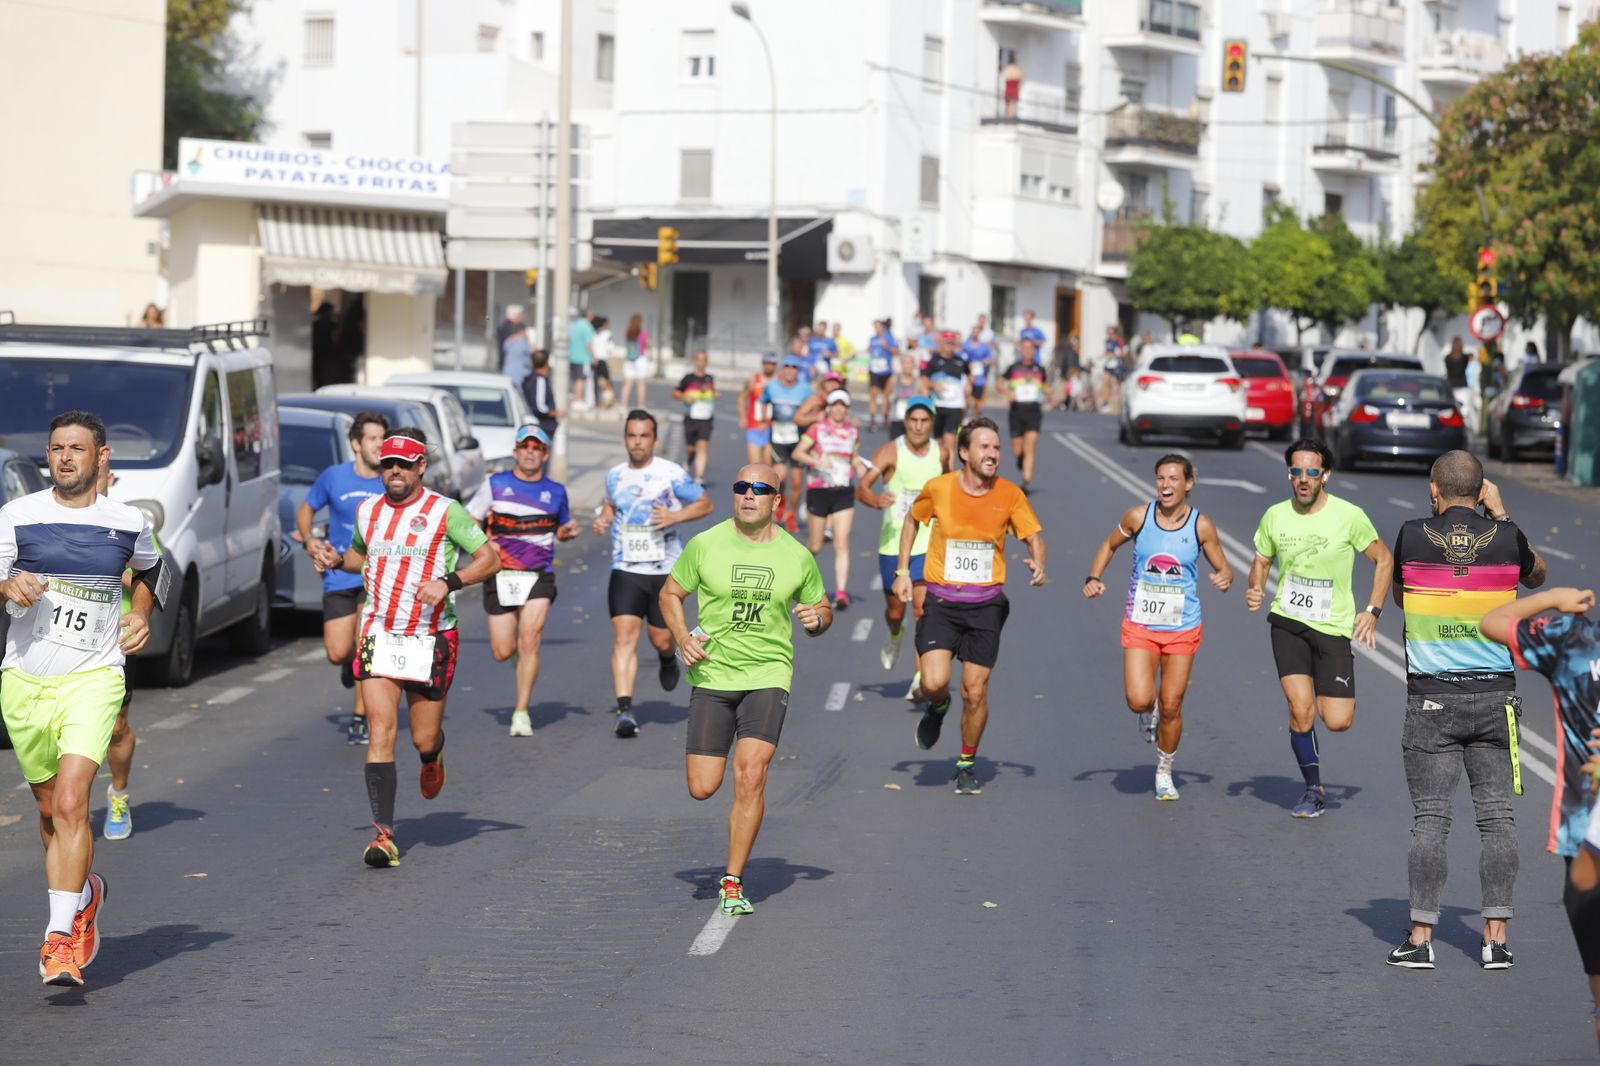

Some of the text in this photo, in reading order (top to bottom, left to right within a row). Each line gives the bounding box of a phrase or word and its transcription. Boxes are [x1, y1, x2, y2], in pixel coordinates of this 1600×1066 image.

[213, 147, 323, 167] CHURROS
[244, 167, 439, 193] PATATAS FRITAS
[954, 556, 978, 572] 306
[60, 583, 83, 598] VUELTA
[83, 591, 89, 600] A
[90, 592, 109, 602] HUELVA
[1289, 590, 1314, 609] 226
[731, 601, 766, 623] 21K
[1141, 599, 1166, 614] 307
[52, 605, 88, 632] 115
[1438, 624, 1478, 634] IBHOLA
